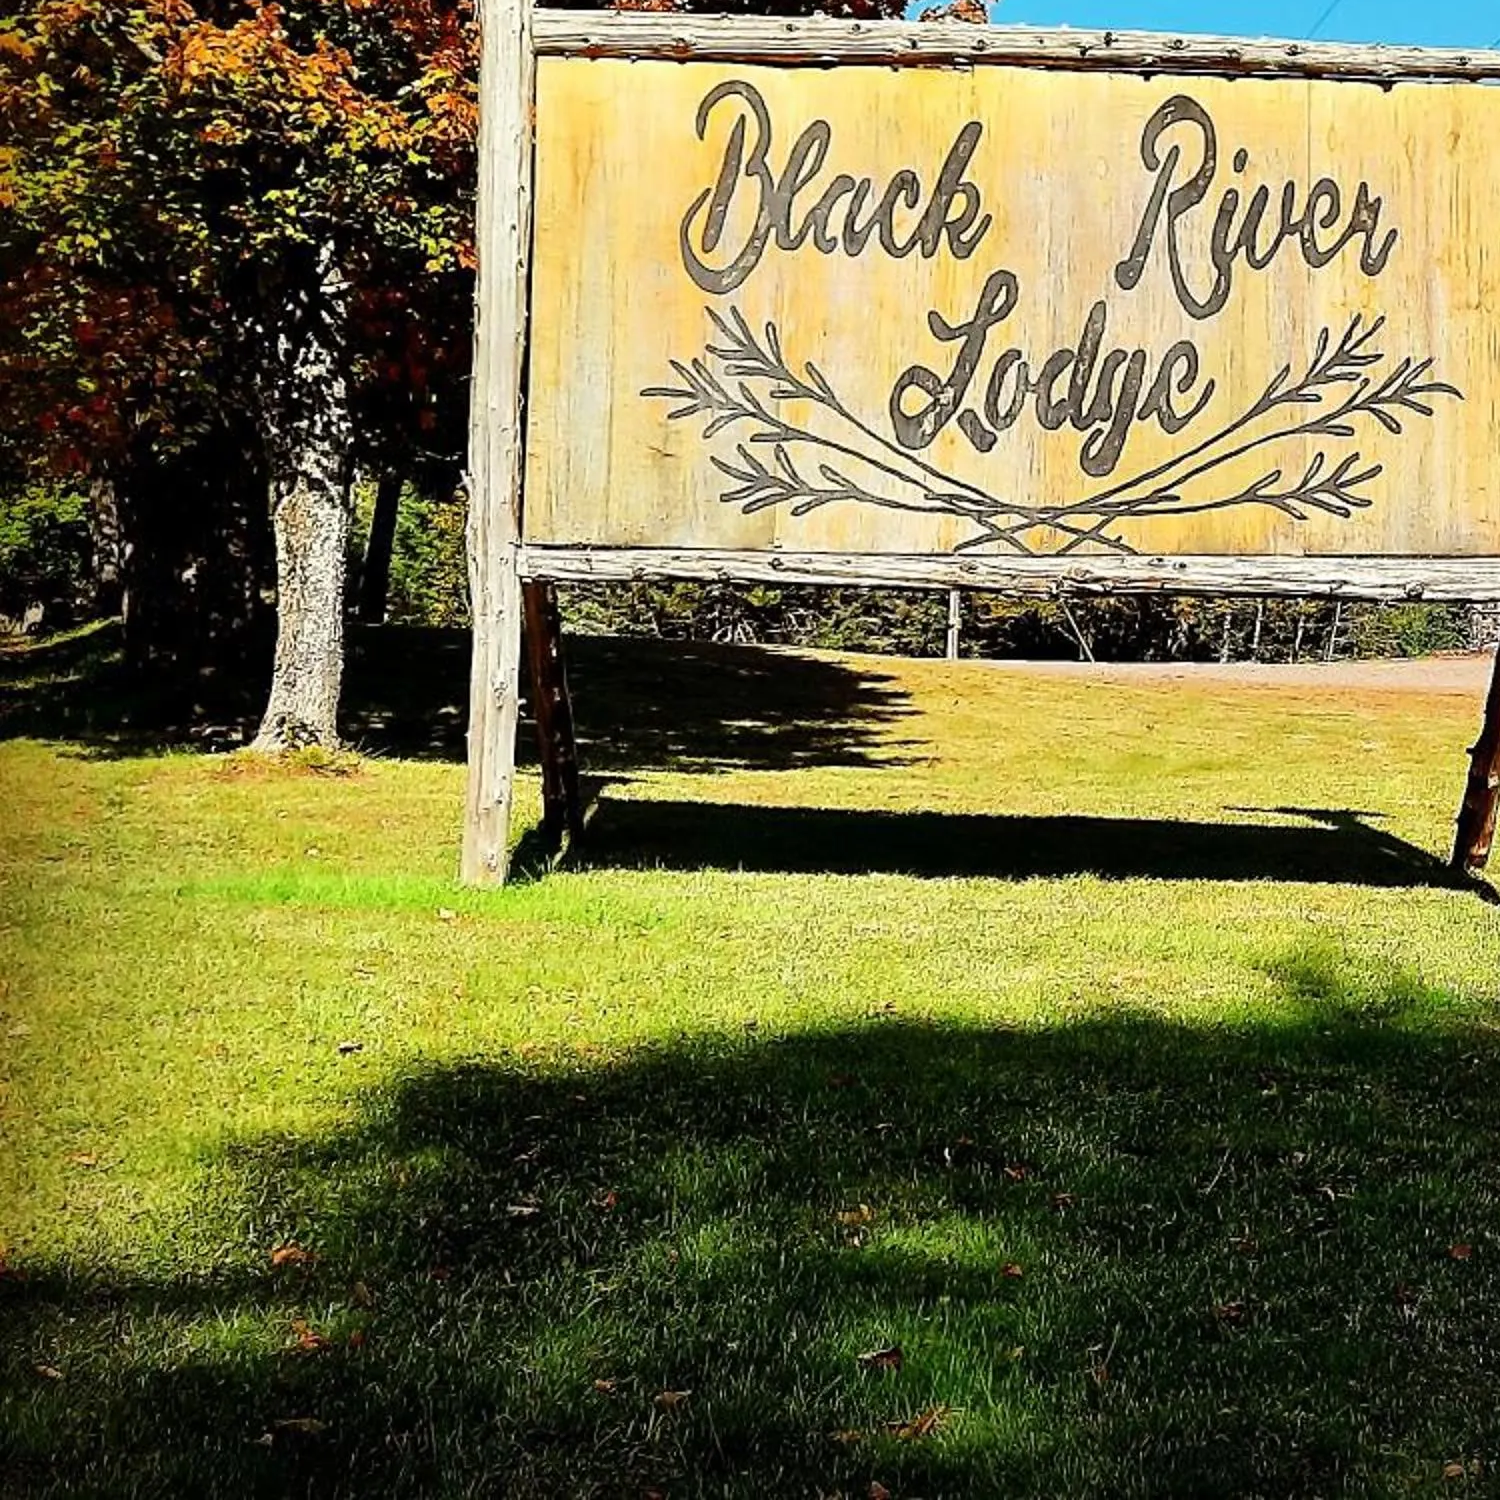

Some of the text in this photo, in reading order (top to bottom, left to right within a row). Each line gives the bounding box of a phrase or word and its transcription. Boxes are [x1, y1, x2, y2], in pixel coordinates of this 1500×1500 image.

[682, 80, 1397, 319] Black River
[889, 269, 1214, 475] Lodge
